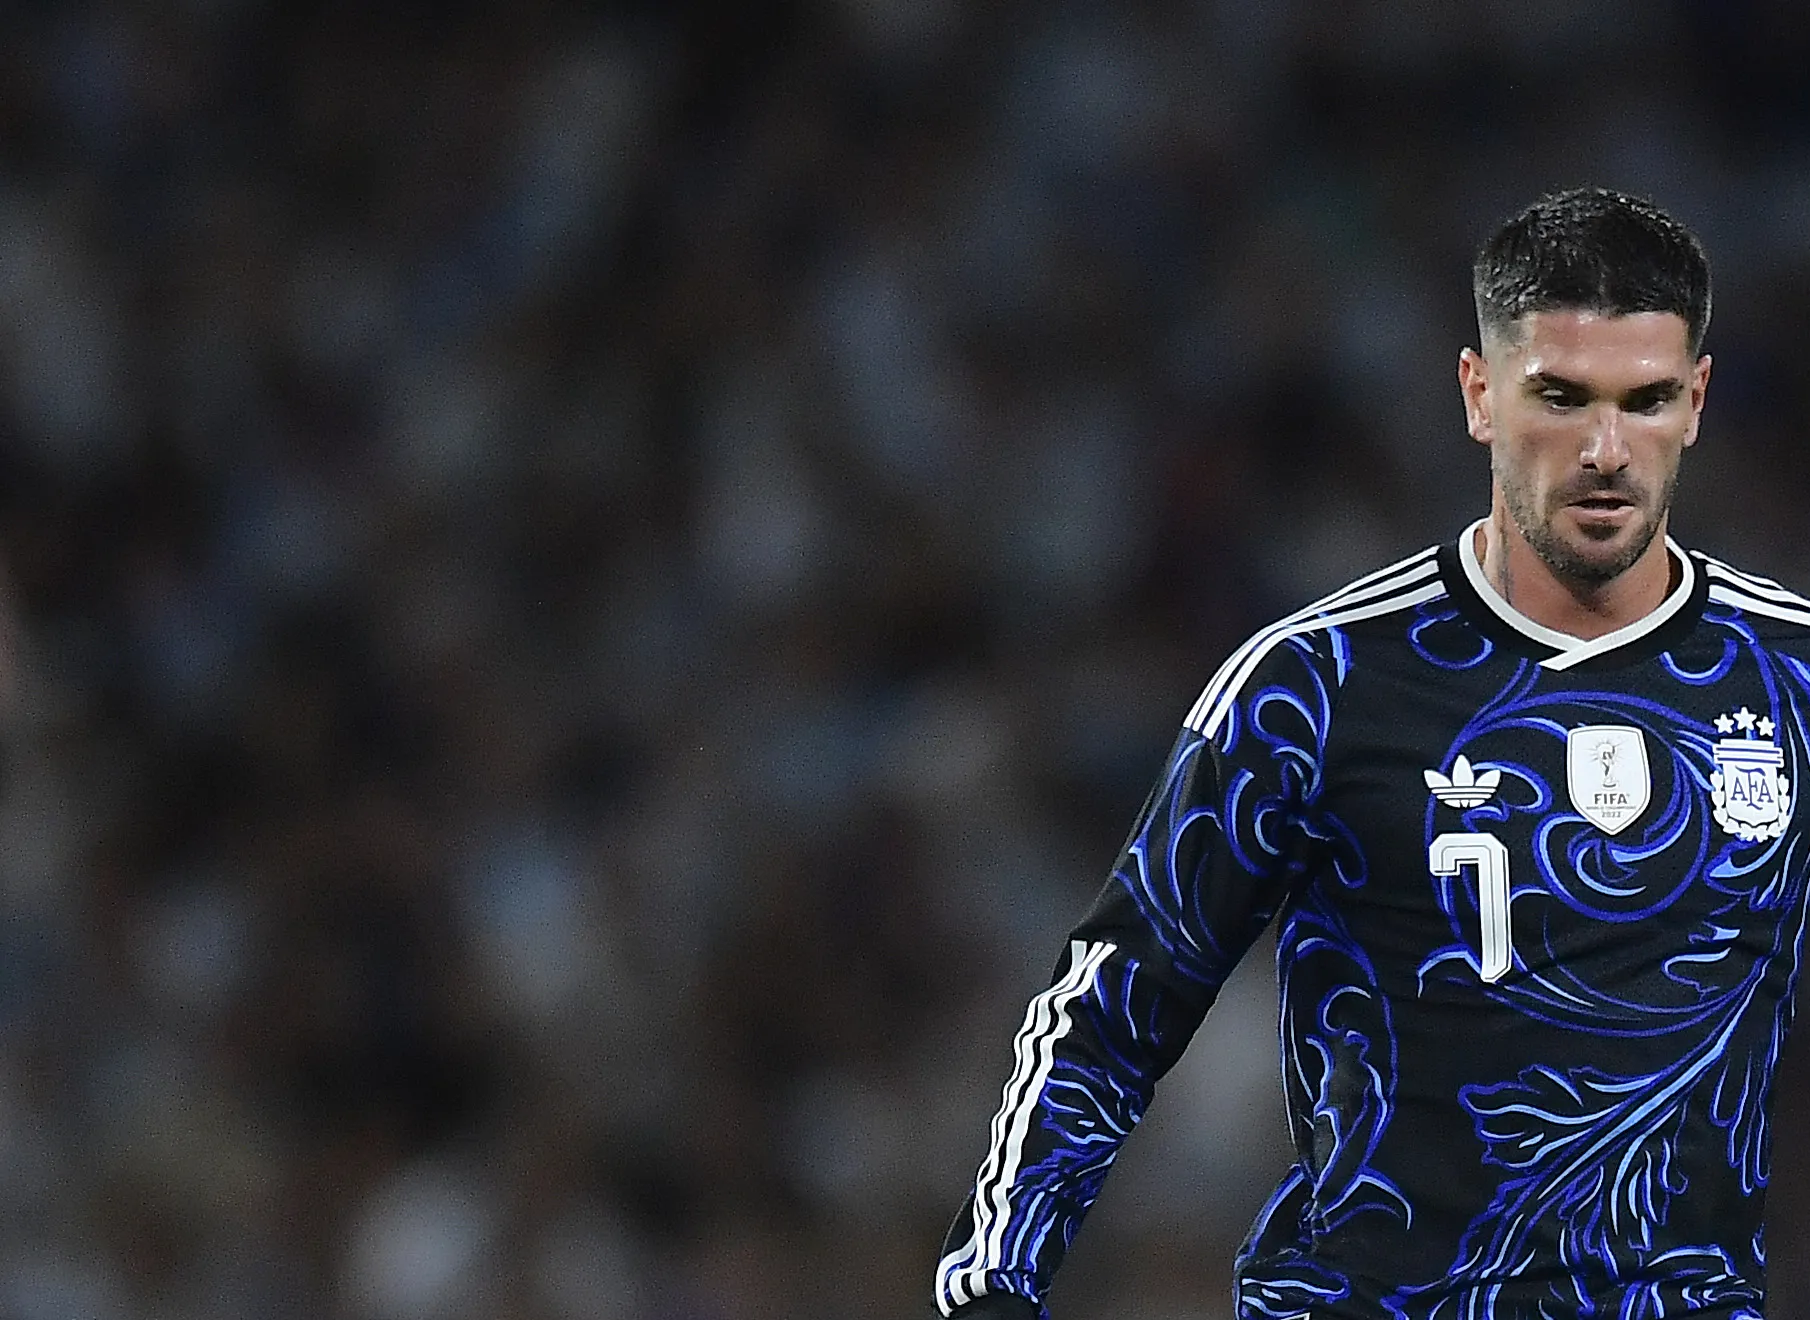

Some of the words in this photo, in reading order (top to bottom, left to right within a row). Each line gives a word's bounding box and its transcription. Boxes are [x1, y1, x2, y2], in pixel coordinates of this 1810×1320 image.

[1594, 793, 1628, 805] FIFA
[1730, 765, 1775, 811] AFA
[1429, 833, 1512, 983] 7
